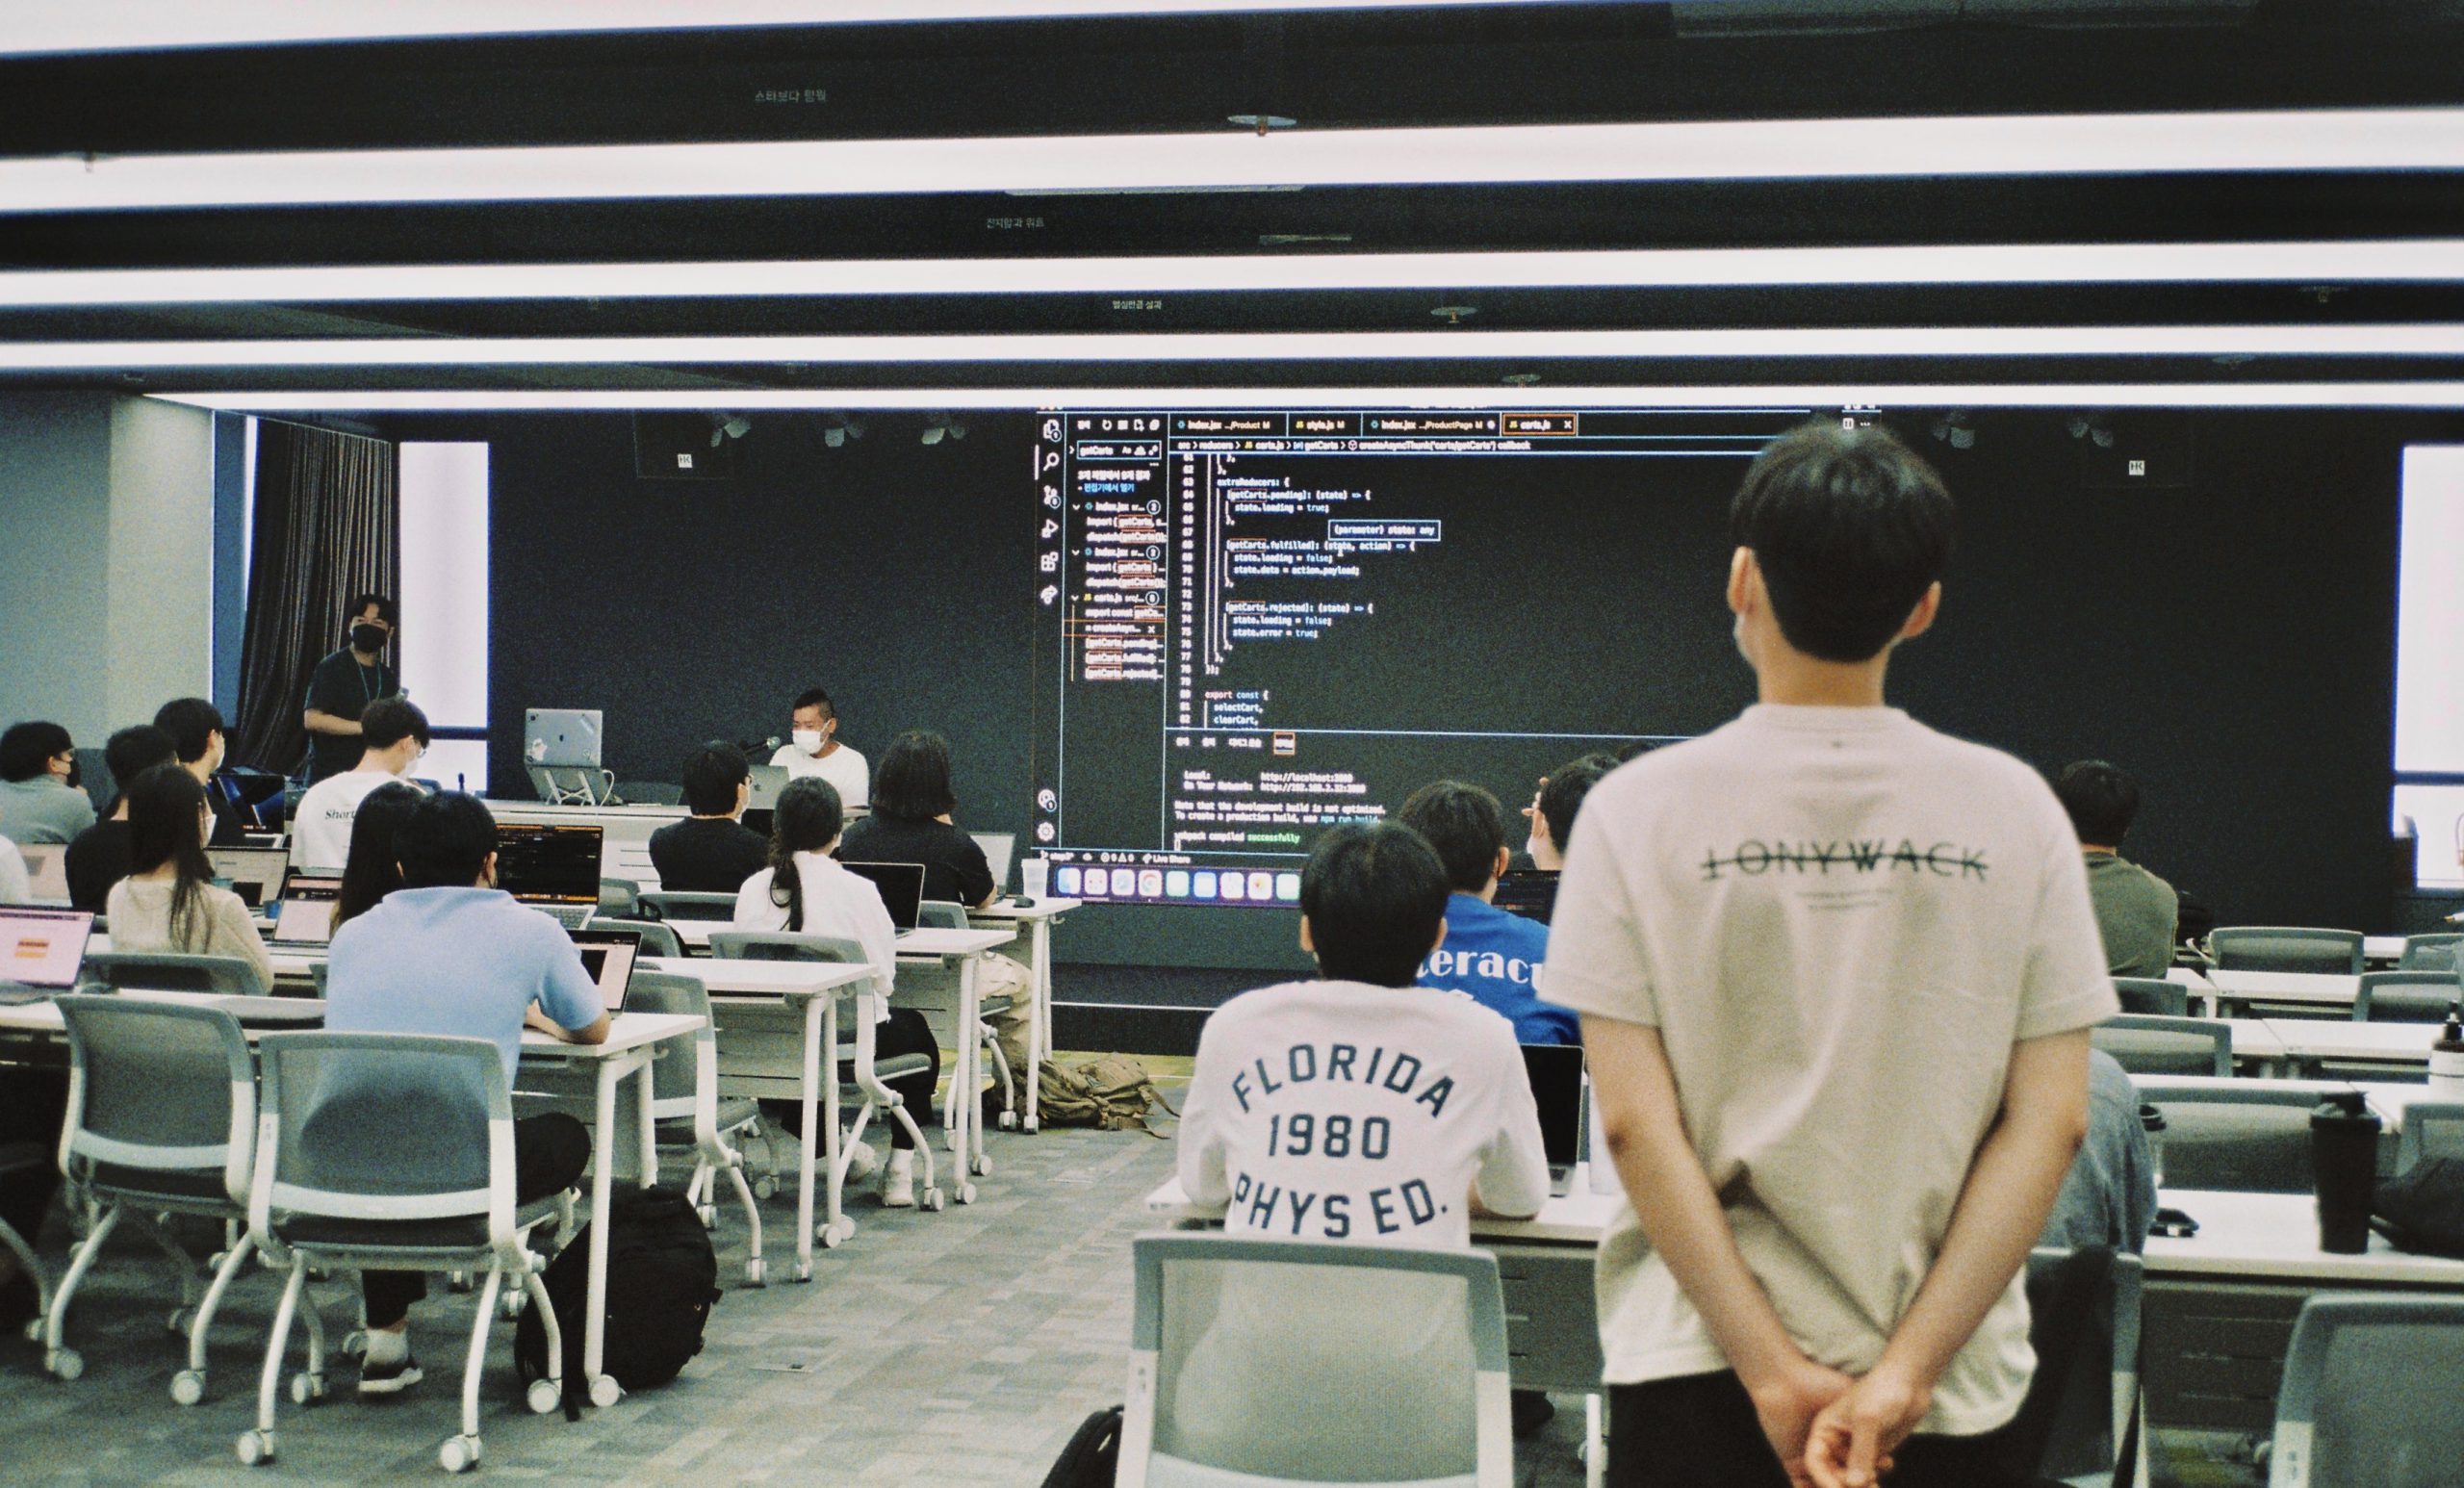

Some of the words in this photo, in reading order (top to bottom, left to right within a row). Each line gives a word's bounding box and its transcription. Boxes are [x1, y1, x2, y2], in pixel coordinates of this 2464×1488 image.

[1205, 691, 1232, 701] export
[1237, 691, 1259, 700] const
[1231, 1043, 1455, 1117] FLORIDA
[1268, 1113, 1391, 1159] 1980
[1371, 1178, 1448, 1235] ED.
